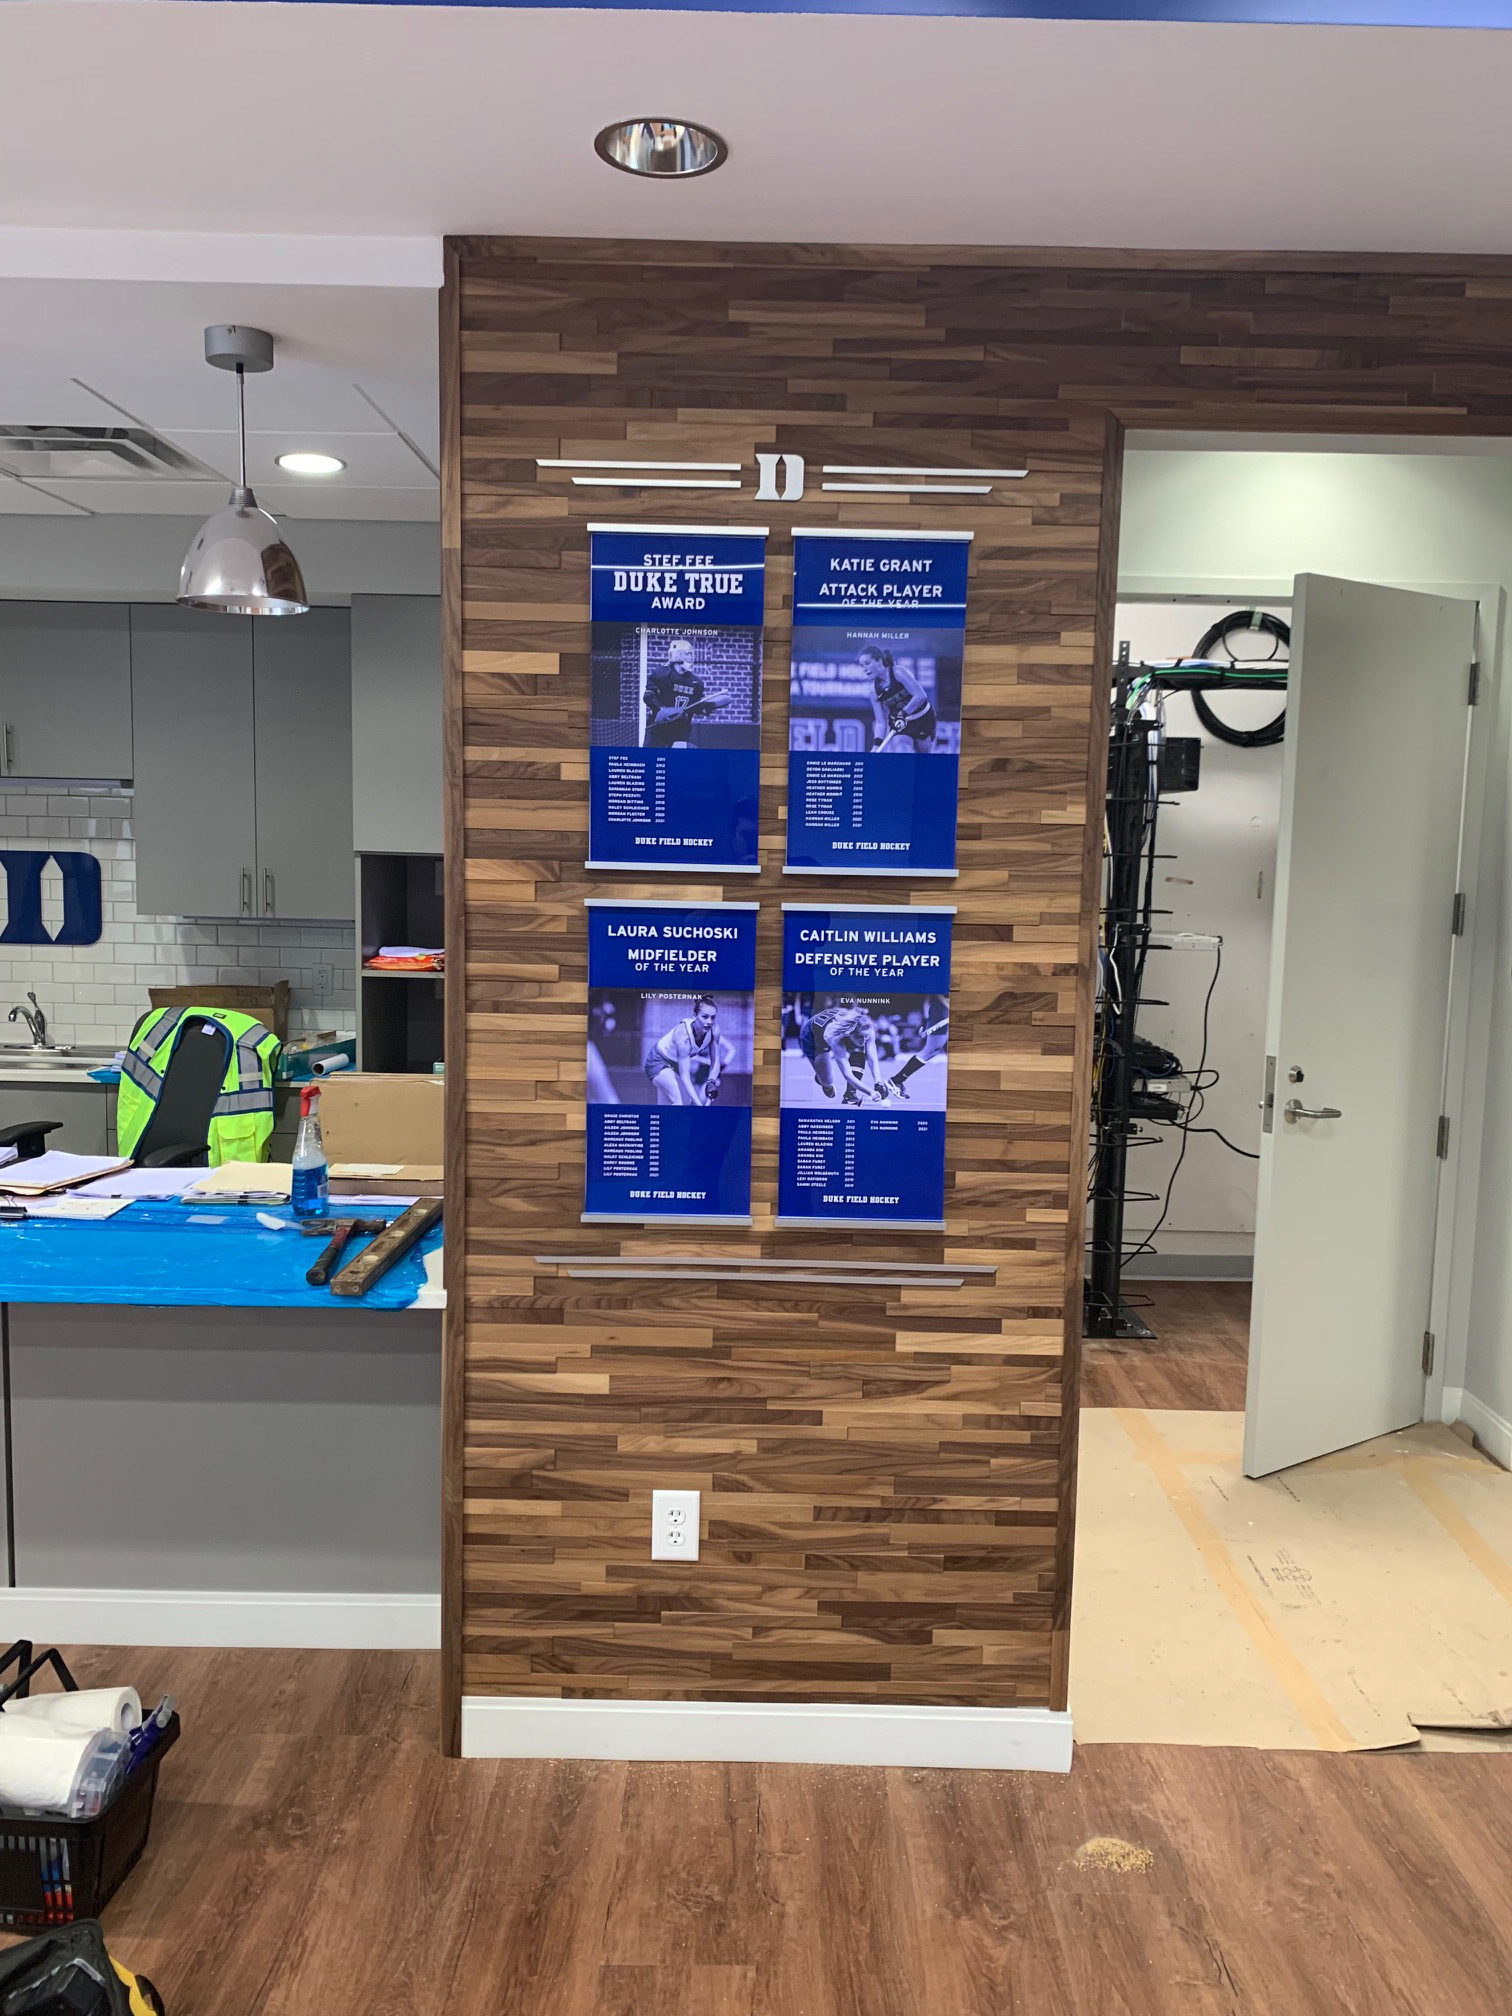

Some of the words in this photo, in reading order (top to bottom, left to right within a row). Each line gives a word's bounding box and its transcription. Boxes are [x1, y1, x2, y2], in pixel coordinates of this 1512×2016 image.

[644, 554, 680, 567] STEF
[686, 556, 714, 567] FEE
[830, 558, 874, 571] KATIE
[880, 560, 932, 572] GRANT
[614, 571, 677, 592] DUKE
[684, 573, 743, 594] TRUE
[819, 583, 878, 596] ATTACK
[882, 584, 943, 598] PLAYER
[651, 597, 706, 610] AWARD
[683, 838, 713, 847] HOCKEY
[880, 842, 910, 850] HOCKEY
[608, 925, 658, 938] LAURA
[663, 927, 738, 939] SUCHOSKI
[800, 930, 859, 943] CAITLIN
[864, 931, 936, 944] WILLIAMS
[628, 949, 717, 962] MIDFIELDER
[795, 953, 877, 966] DEFENSIVE
[883, 954, 940, 967] PLAYER
[635, 963, 650, 972] OF
[653, 963, 675, 972] THE
[679, 964, 709, 973] YEAR
[830, 968, 845, 976] OF
[848, 968, 870, 977] THE
[874, 968, 904, 977] YEAR
[676, 1191, 706, 1199] HOCKEY
[869, 1196, 899, 1204] HOCKEY
